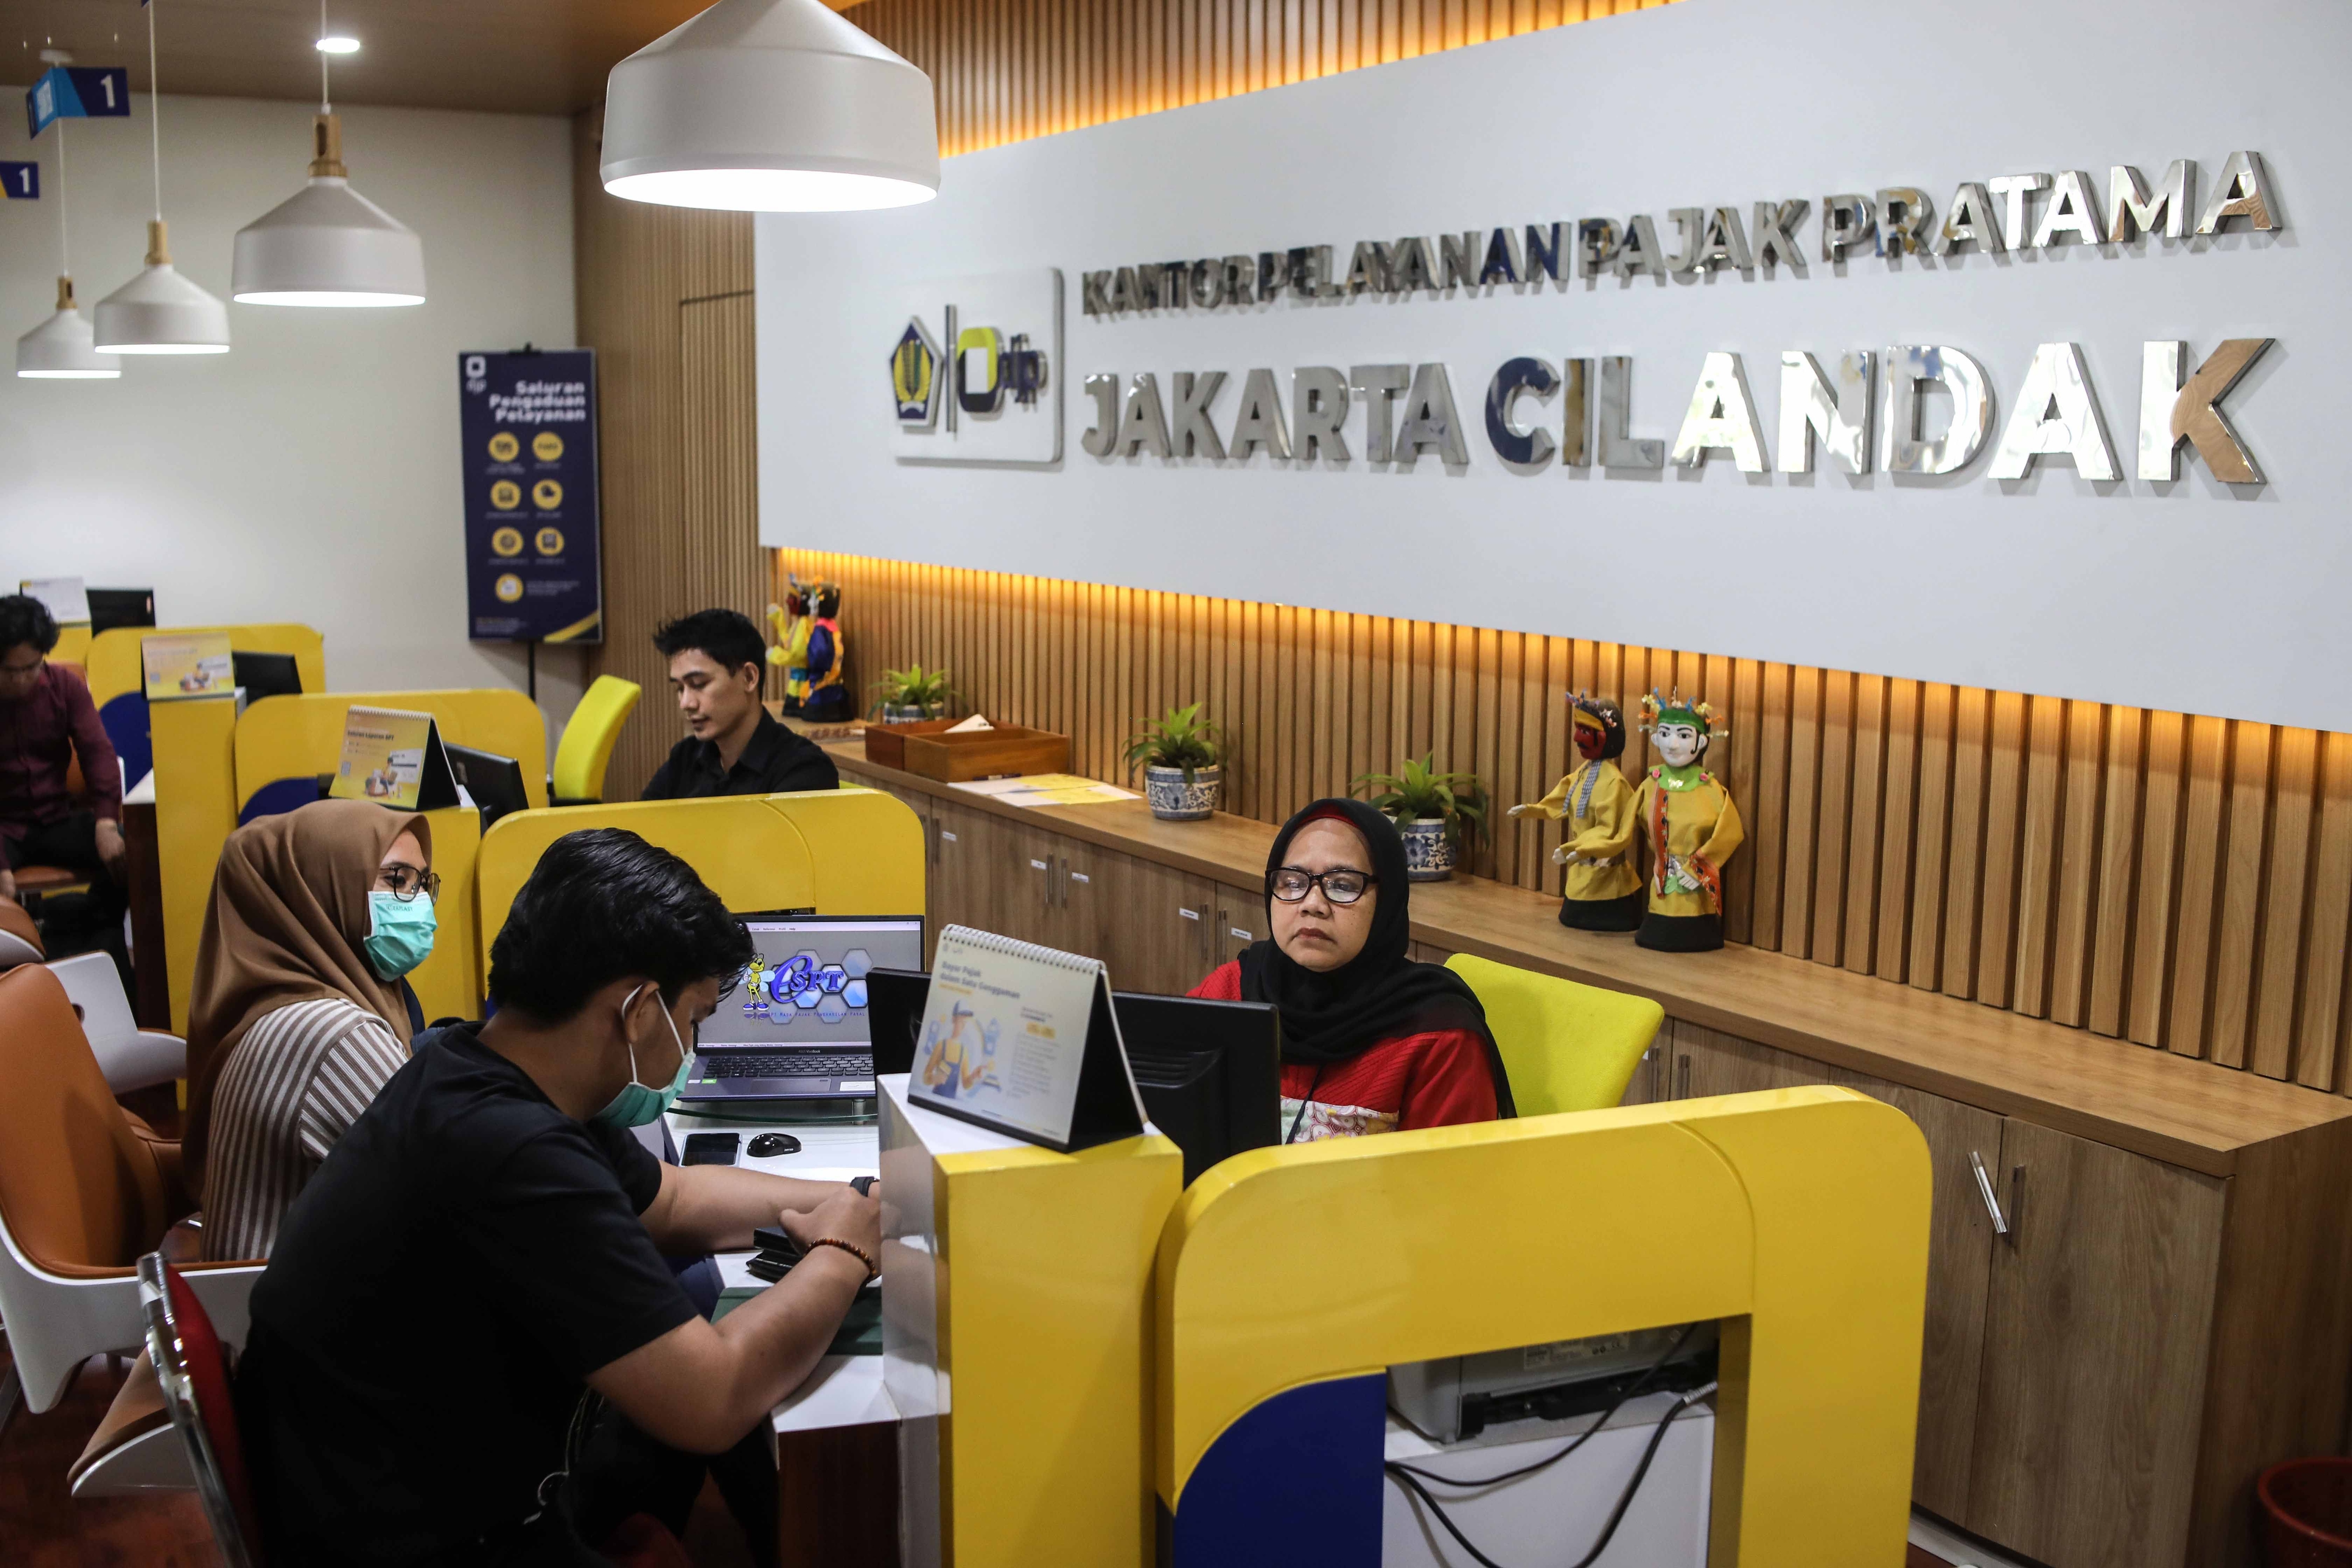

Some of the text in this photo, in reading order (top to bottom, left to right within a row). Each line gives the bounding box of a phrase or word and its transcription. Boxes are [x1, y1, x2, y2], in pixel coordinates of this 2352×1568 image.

[100, 74, 116, 108] 1
[19, 167, 31, 194] 1
[1082, 151, 2283, 315] KANTOR PELAYANAN PAJAK PRATAMA
[516, 379, 586, 394] Saluran
[495, 407, 586, 424] Pelayanan
[1081, 337, 2276, 484] JAKARTA CILANDAK
